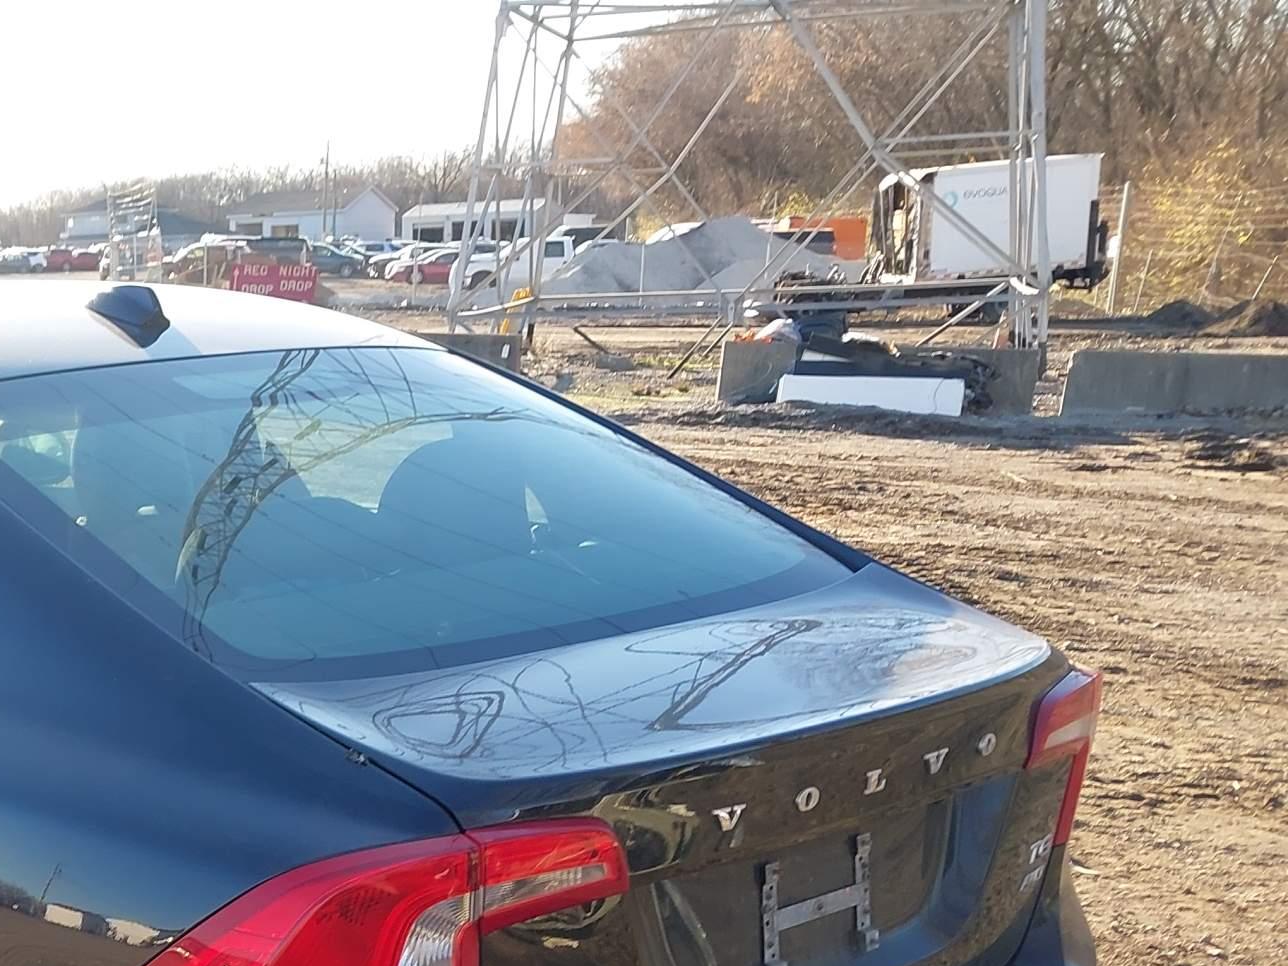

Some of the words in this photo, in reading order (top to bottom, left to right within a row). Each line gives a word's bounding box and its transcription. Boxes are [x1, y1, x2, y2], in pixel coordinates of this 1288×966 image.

[279, 264, 318, 278] NIGHT
[241, 283, 274, 295] DROP
[279, 280, 313, 292] DROP
[712, 732, 998, 832] VOLVO
